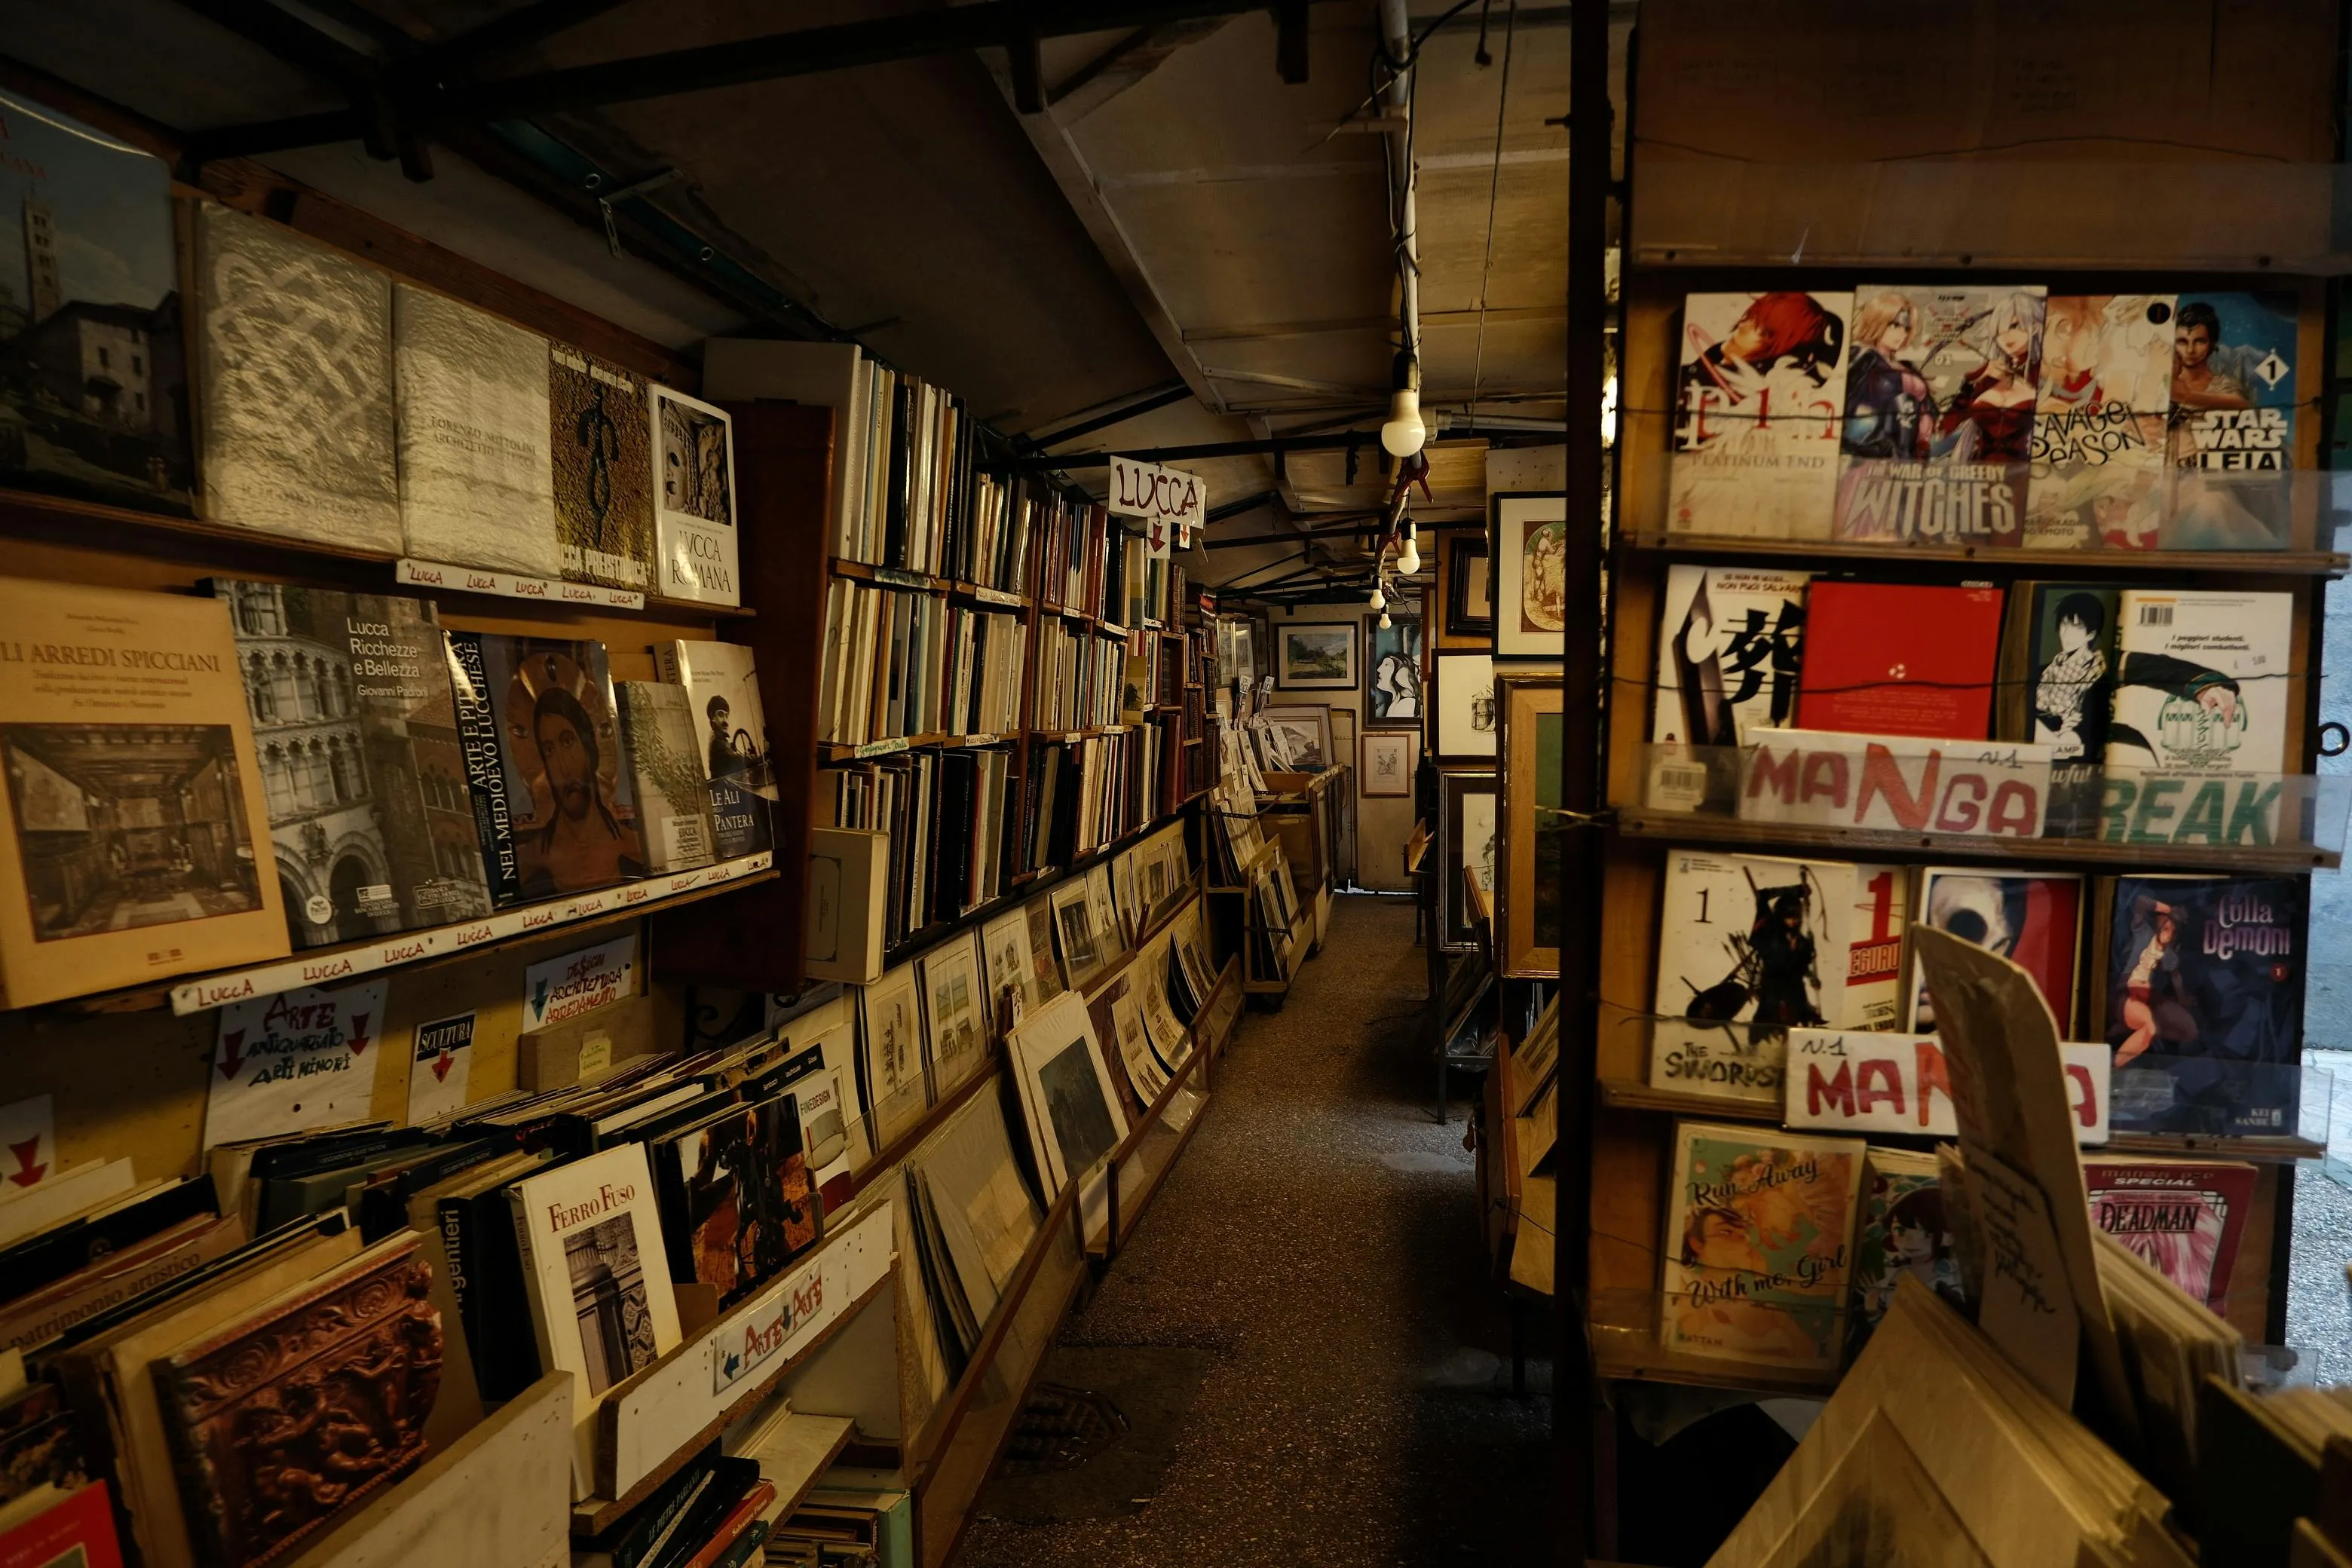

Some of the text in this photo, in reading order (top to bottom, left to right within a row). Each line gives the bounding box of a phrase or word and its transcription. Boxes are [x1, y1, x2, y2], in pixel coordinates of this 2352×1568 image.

[2267, 360, 2276, 381] 1
[2191, 408, 2288, 430] STAR
[2191, 428, 2288, 449] WARS
[1692, 454, 1825, 469] PLATINUM END
[1888, 462, 1923, 480] WAR
[1948, 463, 2007, 482] GREEDY
[2200, 452, 2277, 471] LEIA
[1116, 463, 1200, 520] LUCCA
[1847, 476, 2017, 537] WITCHES
[410, 567, 443, 584] LUCCA
[467, 574, 496, 589] LUCCA
[516, 581, 545, 597] LUCCA
[610, 592, 634, 605] LUCCA
[672, 559, 732, 593] ROMANA
[347, 616, 390, 636] Lucca
[30, 644, 117, 666] ARREDI
[121, 649, 222, 672] SPICCIANI
[350, 637, 418, 658] Ricchezze
[354, 659, 421, 678] e Bellezza
[663, 650, 678, 684] NTERA
[357, 684, 429, 697] Giovanni Padroni
[464, 642, 496, 739] LUCCHESE
[464, 724, 480, 738] E
[466, 740, 488, 789] ARTE
[482, 743, 512, 841] MEDIOEVO
[709, 789, 741, 807] LE ALI
[1746, 742, 2038, 836] MANGA
[714, 813, 755, 831] PANTERA
[499, 843, 516, 881] NEL
[1695, 887, 1713, 924] 1
[1867, 871, 1894, 942] 1
[198, 978, 255, 1008] LUCCA
[303, 958, 353, 981] LUCCA
[384, 942, 425, 963] LUCCA
[458, 925, 494, 946] LUCCA
[522, 909, 554, 929] LUCCA
[577, 899, 604, 917] LUCCA
[626, 889, 649, 903] LUCCA
[672, 878, 691, 891] LUCCA
[707, 868, 730, 880] LUCCA
[420, 1021, 472, 1052] SCULTURA
[1683, 1041, 1710, 1057] THE
[1686, 1158, 1825, 1206] Run Away
[2114, 1177, 2197, 1187] SPECIAL
[547, 1184, 636, 1233] FERRO FUSO
[2100, 1202, 2201, 1233] DEADMAN
[127, 1252, 201, 1295] artistico
[1685, 1275, 1749, 1309] With
[1796, 1244, 1847, 1289] Girl
